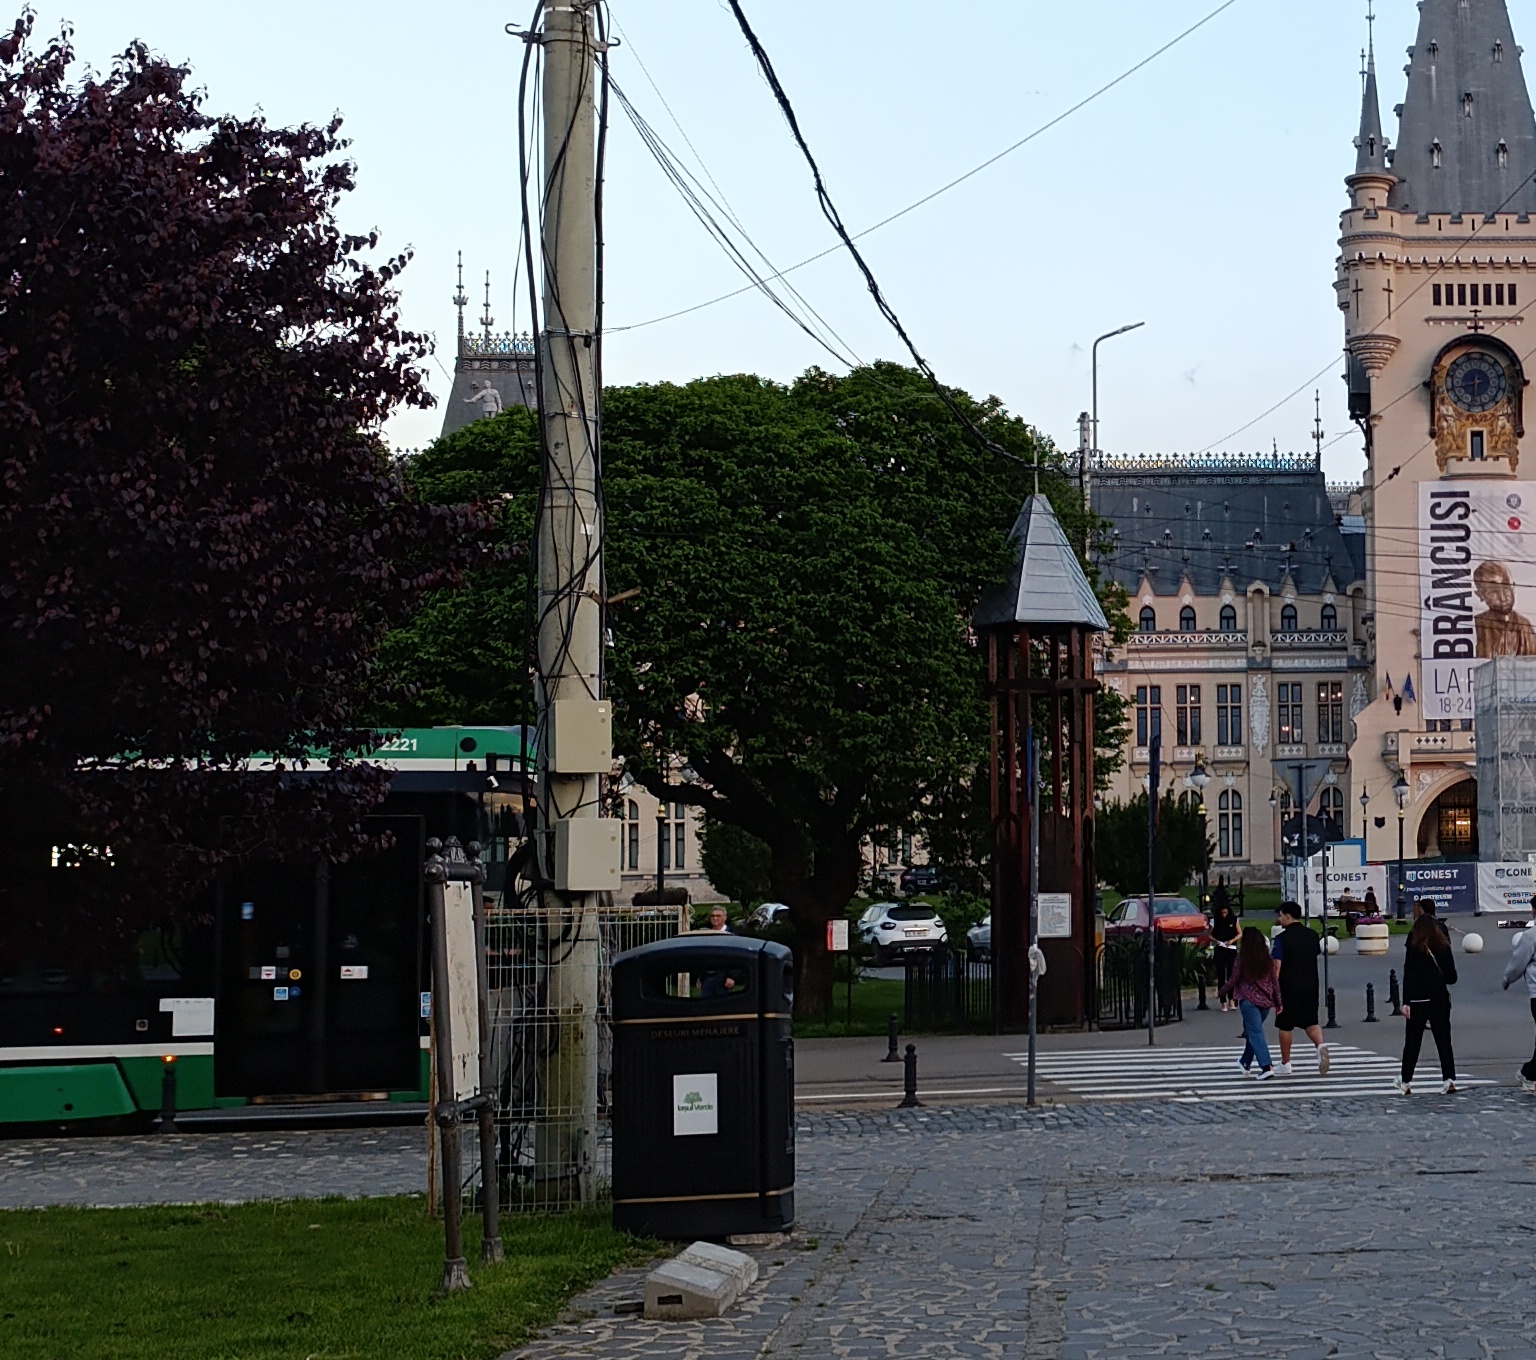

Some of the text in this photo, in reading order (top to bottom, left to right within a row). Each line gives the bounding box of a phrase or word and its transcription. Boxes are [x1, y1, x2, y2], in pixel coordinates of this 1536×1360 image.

[1424, 490, 1478, 659] BRÂNCUȘI
[1434, 667, 1461, 694] LA
[1438, 697, 1473, 714] 18-24
[1326, 872, 1368, 882] CONEST
[1417, 869, 1459, 879] CONEST
[1506, 867, 1533, 877] CONE
